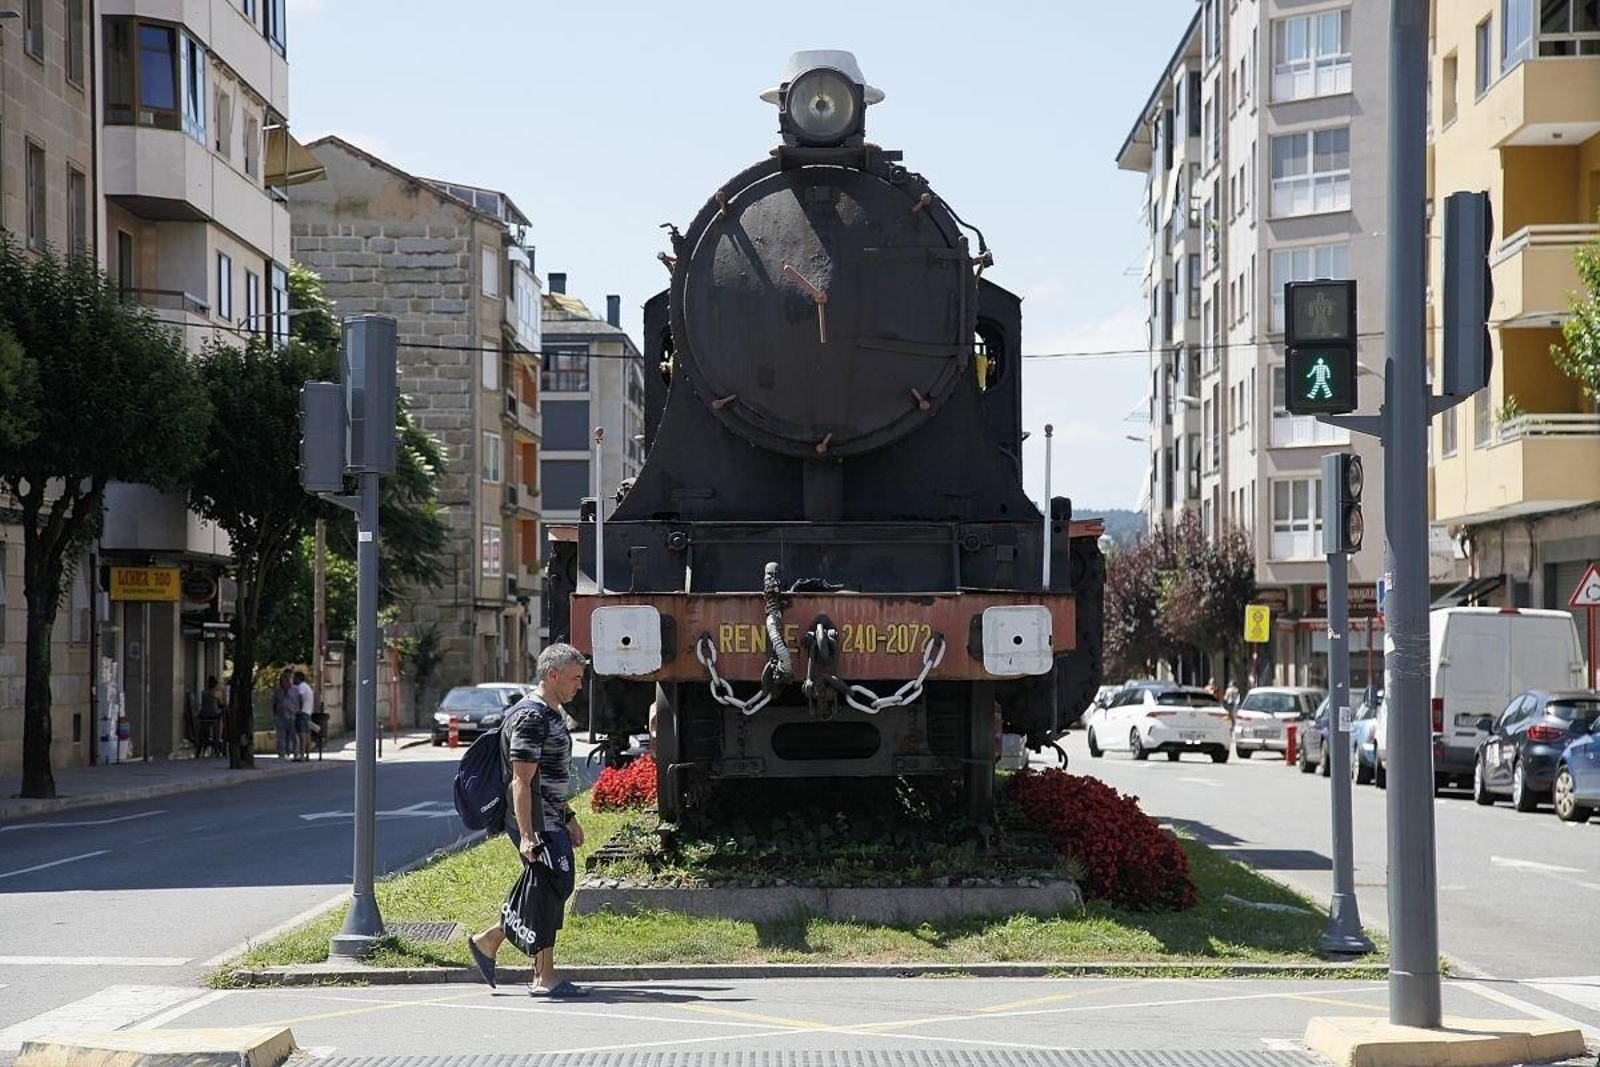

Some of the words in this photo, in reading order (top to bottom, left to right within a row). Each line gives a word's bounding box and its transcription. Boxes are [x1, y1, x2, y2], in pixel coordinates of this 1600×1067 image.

[719, 624, 799, 653] RENE
[842, 623, 931, 653] 240-2072
[501, 902, 537, 944] adidas
